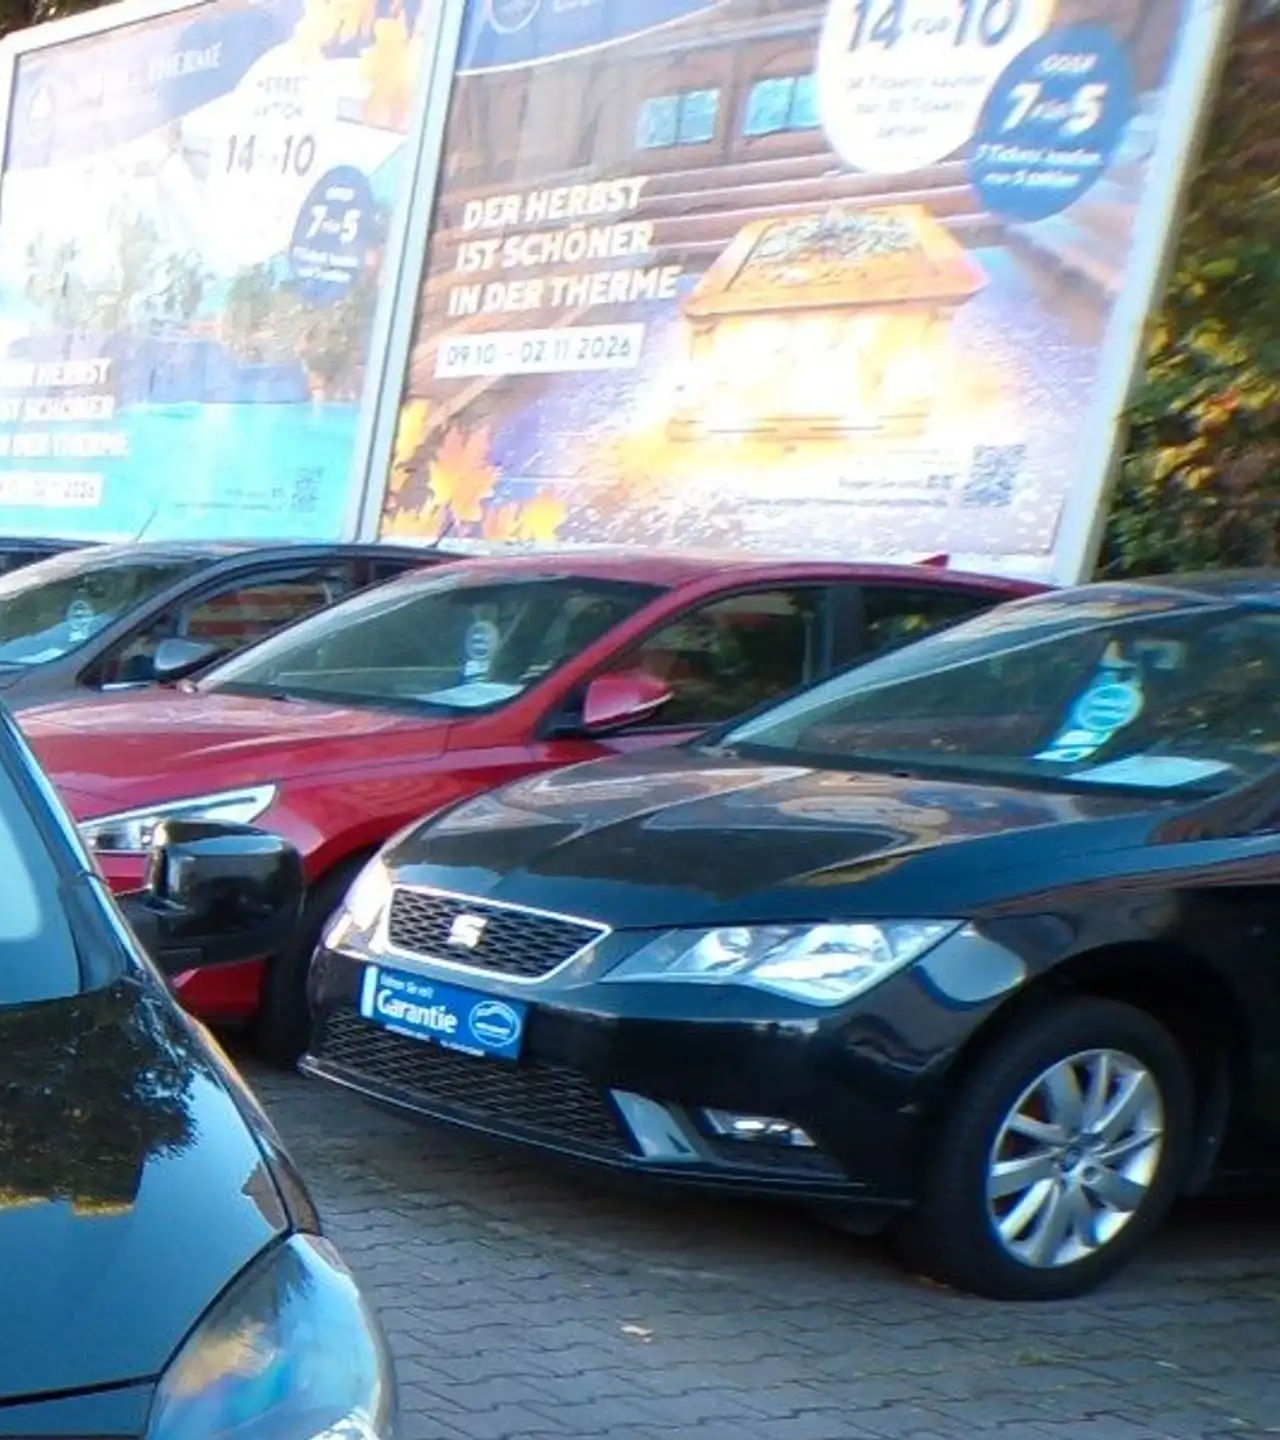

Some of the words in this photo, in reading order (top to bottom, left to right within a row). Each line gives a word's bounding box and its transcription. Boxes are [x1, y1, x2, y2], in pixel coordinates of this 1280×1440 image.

[847, 0, 905, 53] 14
[952, 0, 1016, 49] 10
[999, 82, 1044, 135] 7
[1060, 82, 1109, 139] 5
[225, 134, 256, 175] 14
[280, 134, 316, 178] 10
[462, 194, 522, 231] DER
[524, 176, 648, 223] HERBST
[455, 238, 502, 273] IST
[502, 221, 654, 269] SCHÖNER
[448, 284, 482, 317] IN
[481, 279, 546, 313] DER
[549, 265, 683, 307] THERME
[376, 987, 459, 1034] Garantie
